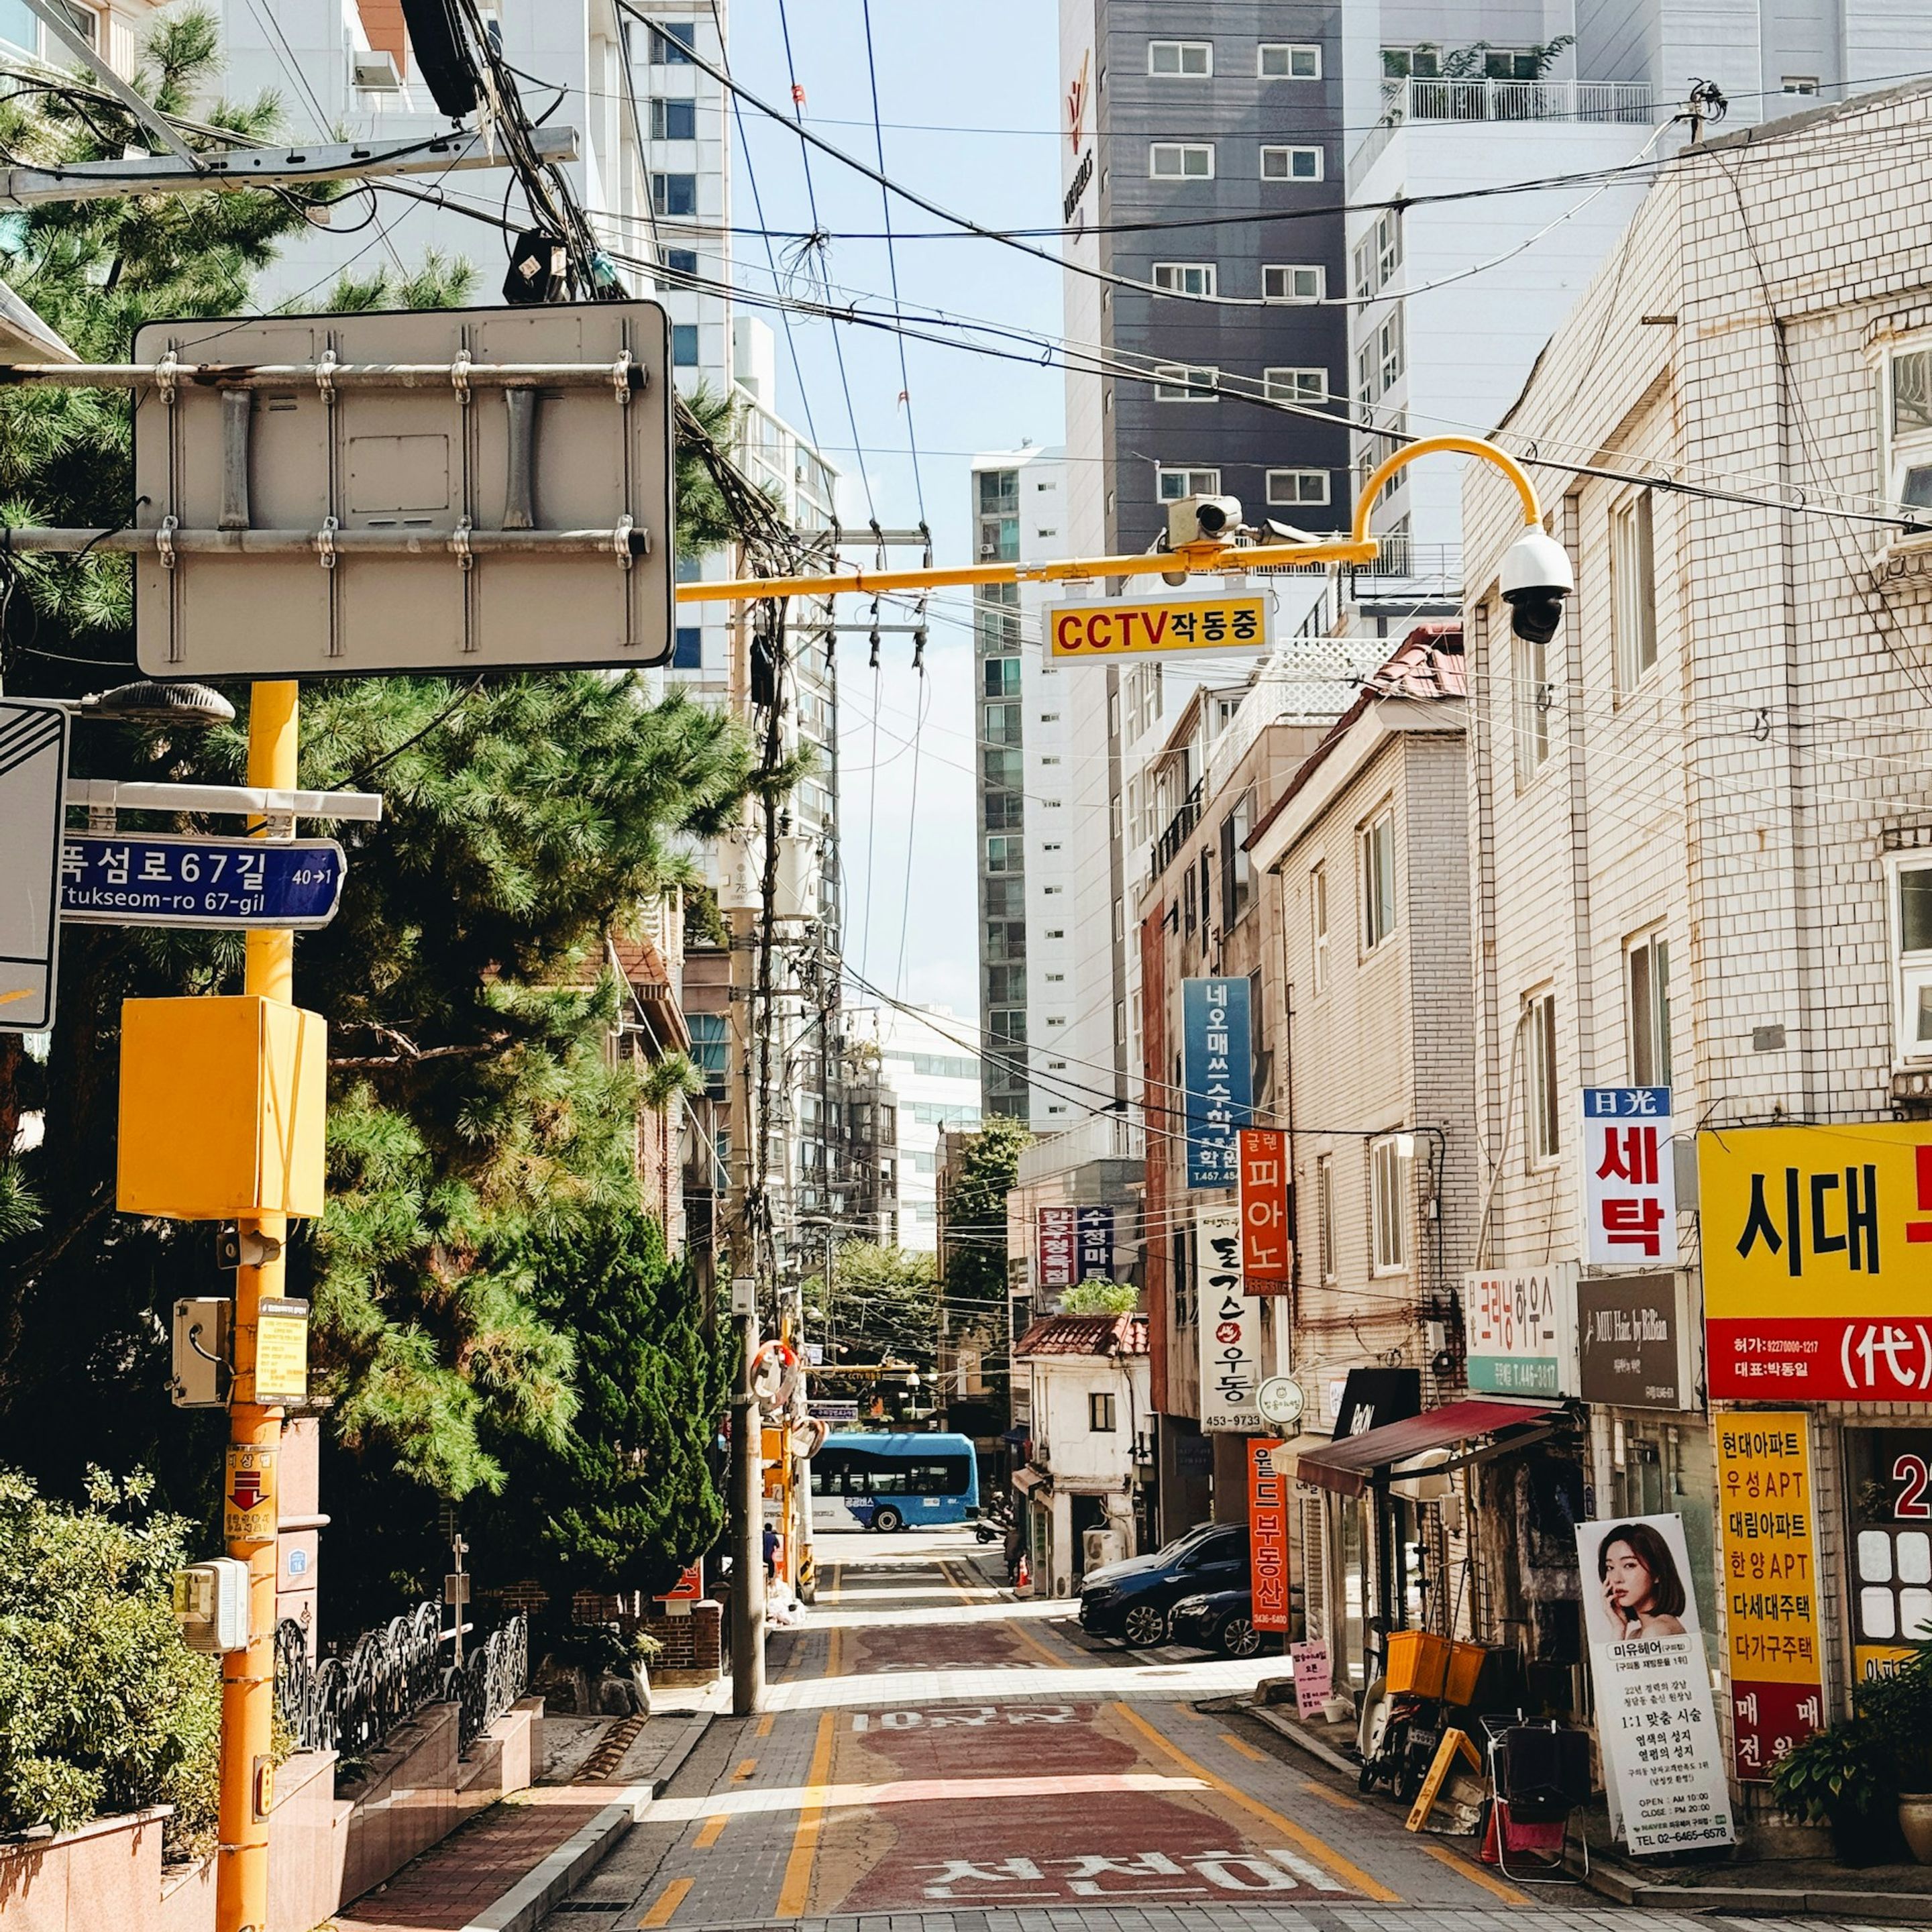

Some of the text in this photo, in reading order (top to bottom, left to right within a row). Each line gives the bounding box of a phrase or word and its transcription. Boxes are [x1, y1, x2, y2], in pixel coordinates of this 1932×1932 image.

[204, 892, 264, 916] 67-gil
[1595, 1090, 1658, 1115] 日光
[1595, 1126, 1665, 1256] 세탁
[1247, 1159, 1283, 1269] 피아노
[1214, 1346, 1253, 1402] 우동
[1206, 1415, 1260, 1426] 453-9733
[1722, 1431, 1800, 1460] 현대아파트
[1729, 1511, 1807, 1540] 대림아파트
[1255, 1515, 1283, 1609] 부동산
[1733, 1592, 1811, 1623] 다세대주택
[1614, 1640, 1662, 1658] 미유헤어
[1735, 1633, 1813, 1664] 다가구주택
[1625, 1684, 1642, 1695] 22년
[1622, 1707, 1702, 1729] 1:1 맞춤 시술
[1670, 1729, 1691, 1743] 성지
[1673, 1743, 1694, 1758] 성지
[1639, 1792, 1709, 1807] OPEN AM 10:00
[1641, 1803, 1711, 1818] CLOSE PM 20:00
[1635, 1827, 1727, 1846] TEL 02-6465-6578
[1641, 1821, 1668, 1831] NAVER
[913, 1848, 1348, 1899] 천천히
